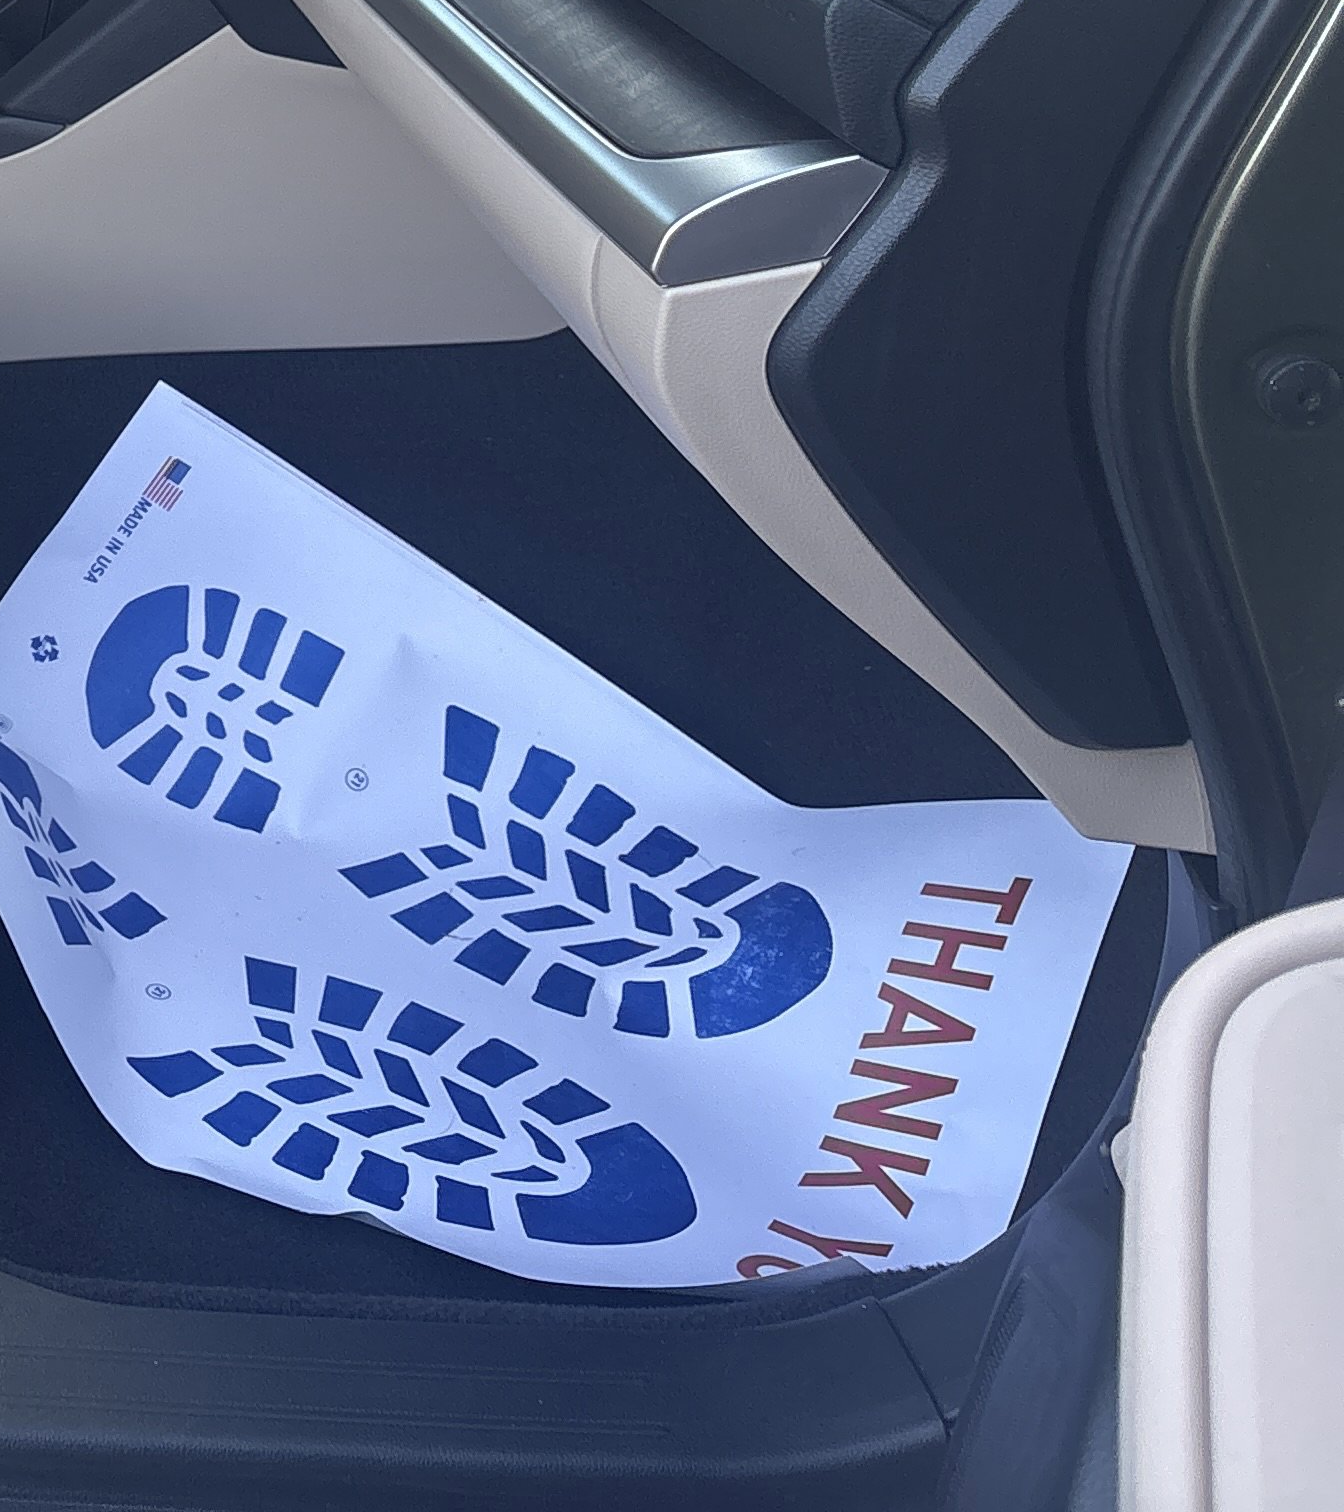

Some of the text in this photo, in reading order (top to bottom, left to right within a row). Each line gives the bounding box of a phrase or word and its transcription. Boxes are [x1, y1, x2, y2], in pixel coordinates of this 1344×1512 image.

[83, 497, 153, 584] MADE IN USA
[798, 876, 1034, 1220] THANK
